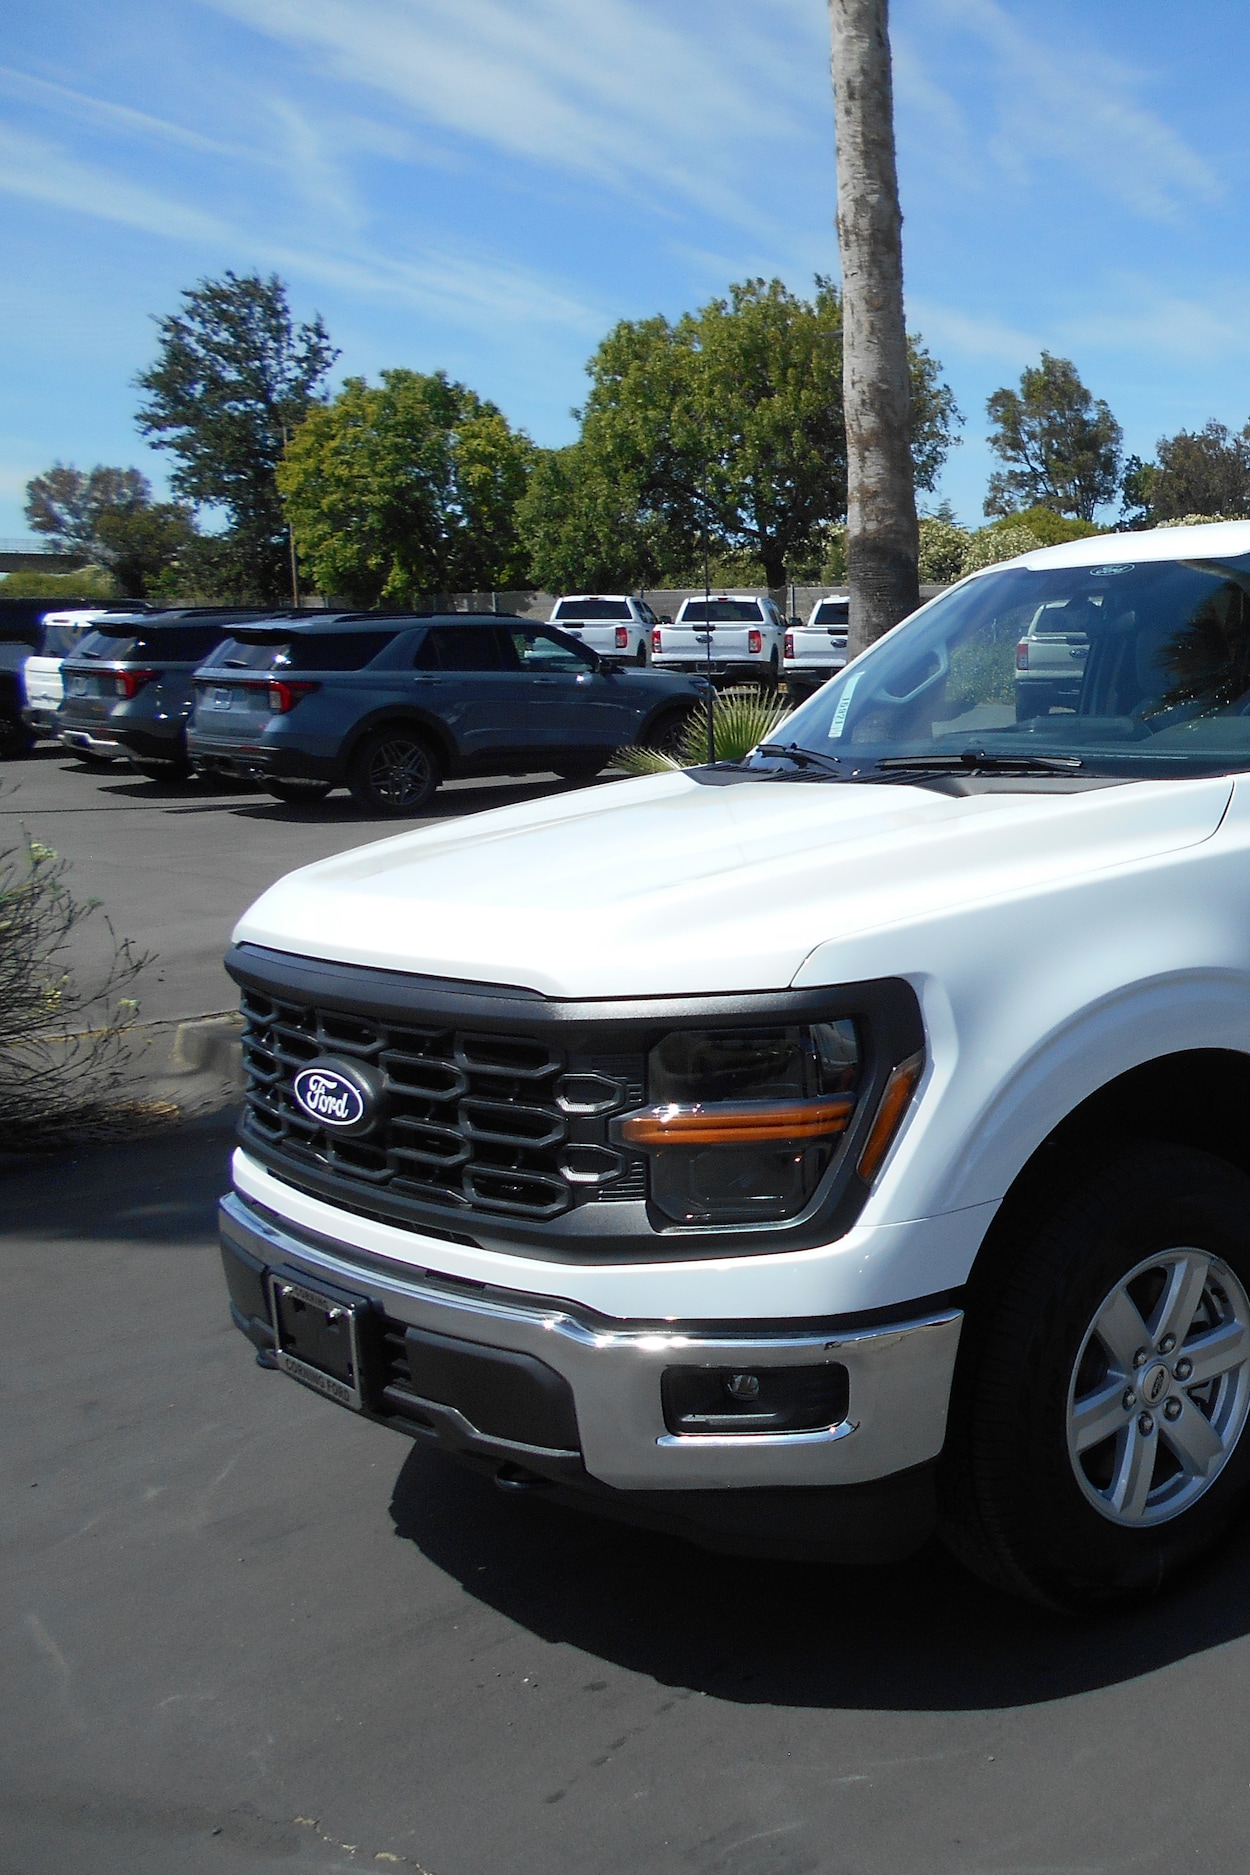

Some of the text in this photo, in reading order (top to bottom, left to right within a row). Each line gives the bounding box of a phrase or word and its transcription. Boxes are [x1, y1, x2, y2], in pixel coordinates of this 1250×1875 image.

[306, 1074, 349, 1119] Ford
[285, 1358, 350, 1402] CORNING FORD
